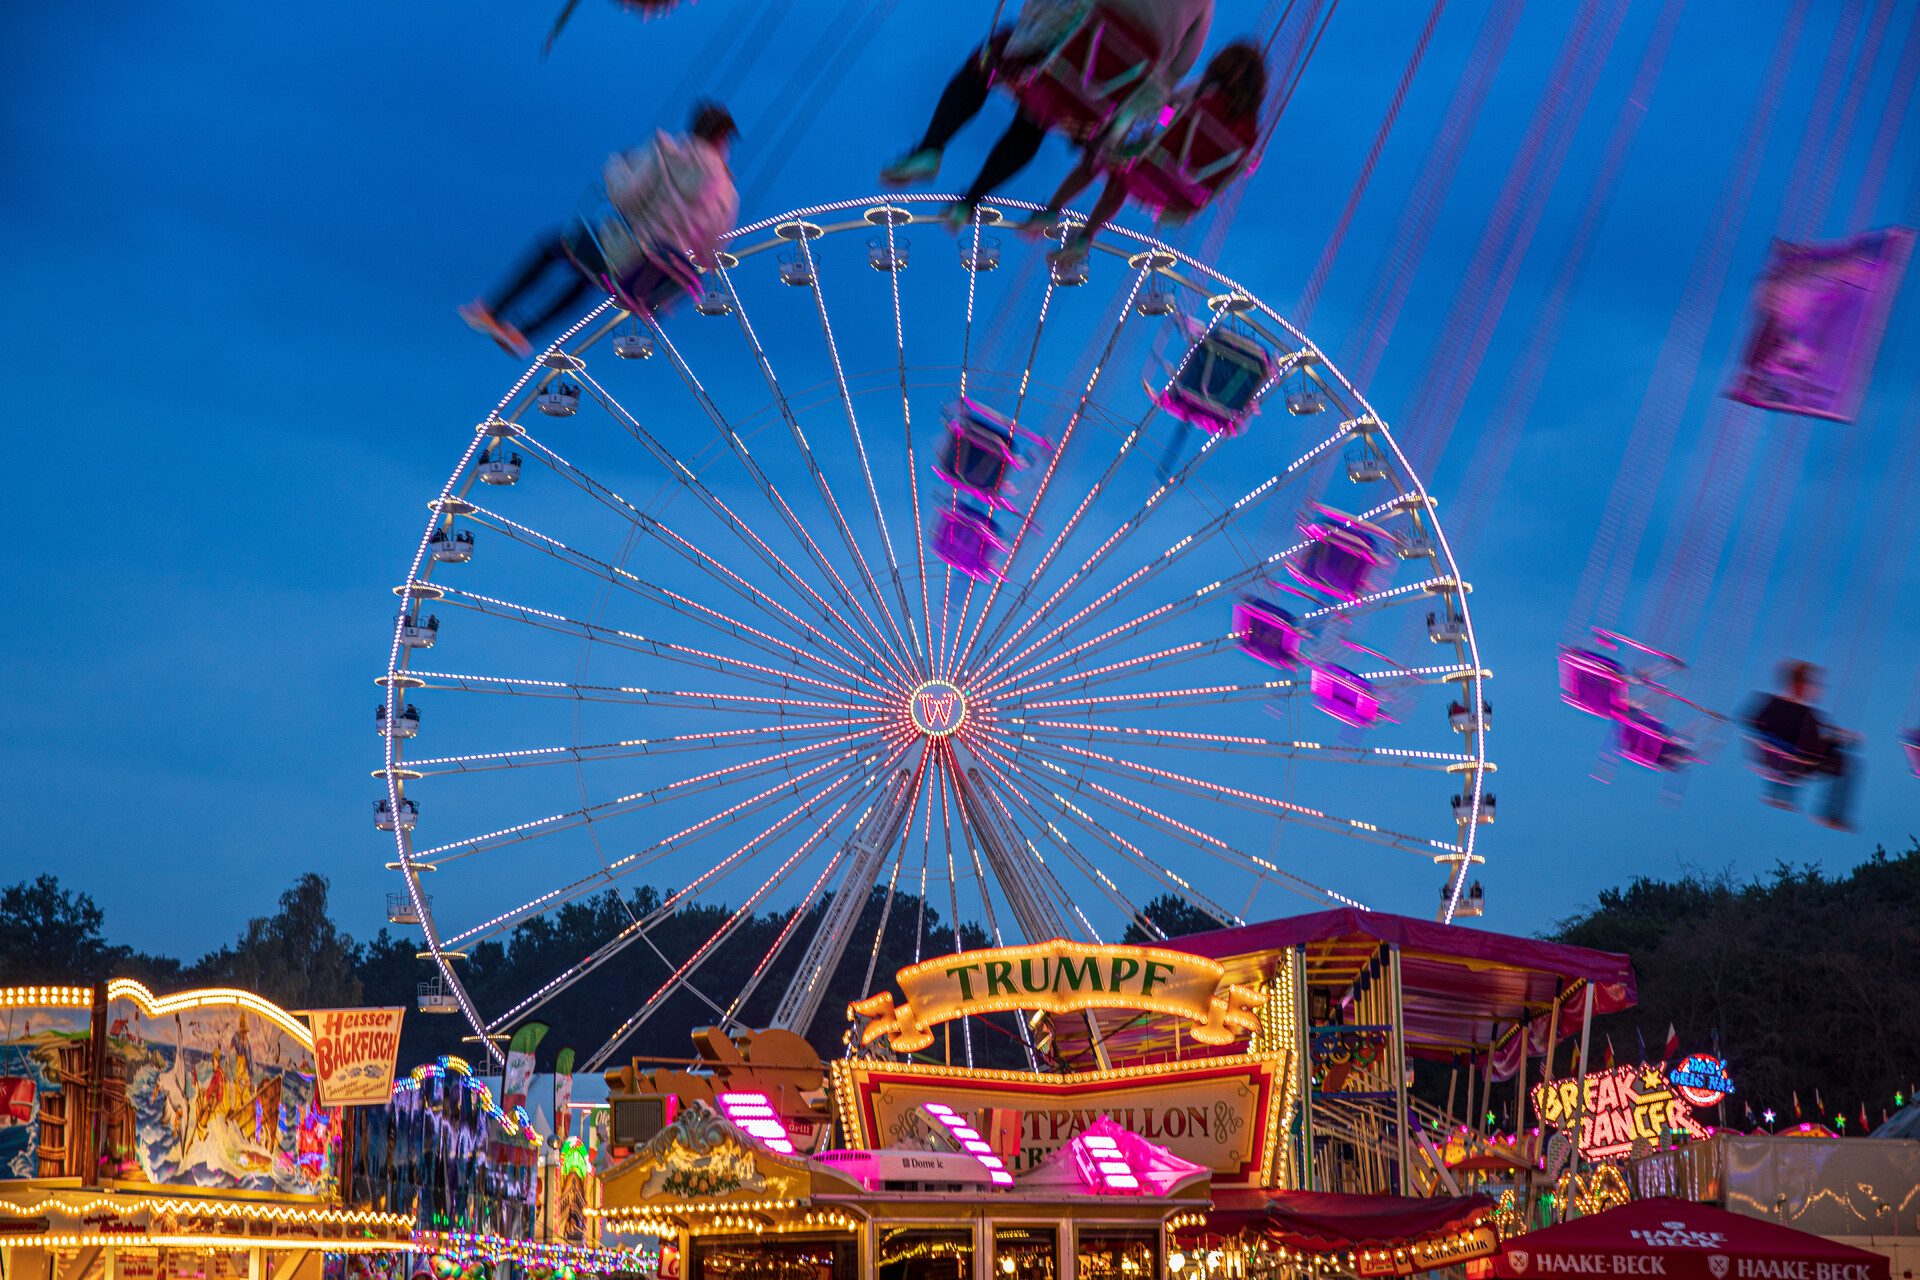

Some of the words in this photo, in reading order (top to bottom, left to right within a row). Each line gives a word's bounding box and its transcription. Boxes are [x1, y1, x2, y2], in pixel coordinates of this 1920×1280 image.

[919, 693, 957, 727] W
[946, 956, 1175, 1001] TRUMPF
[316, 1030, 397, 1080] BACKFISCH
[1536, 1071, 1642, 1121] BREAK
[1630, 1229, 1728, 1242] HAAKE
[1536, 1253, 1667, 1275] HAAKE-BECK
[1737, 1258, 1872, 1280] HAAKE-BECK
